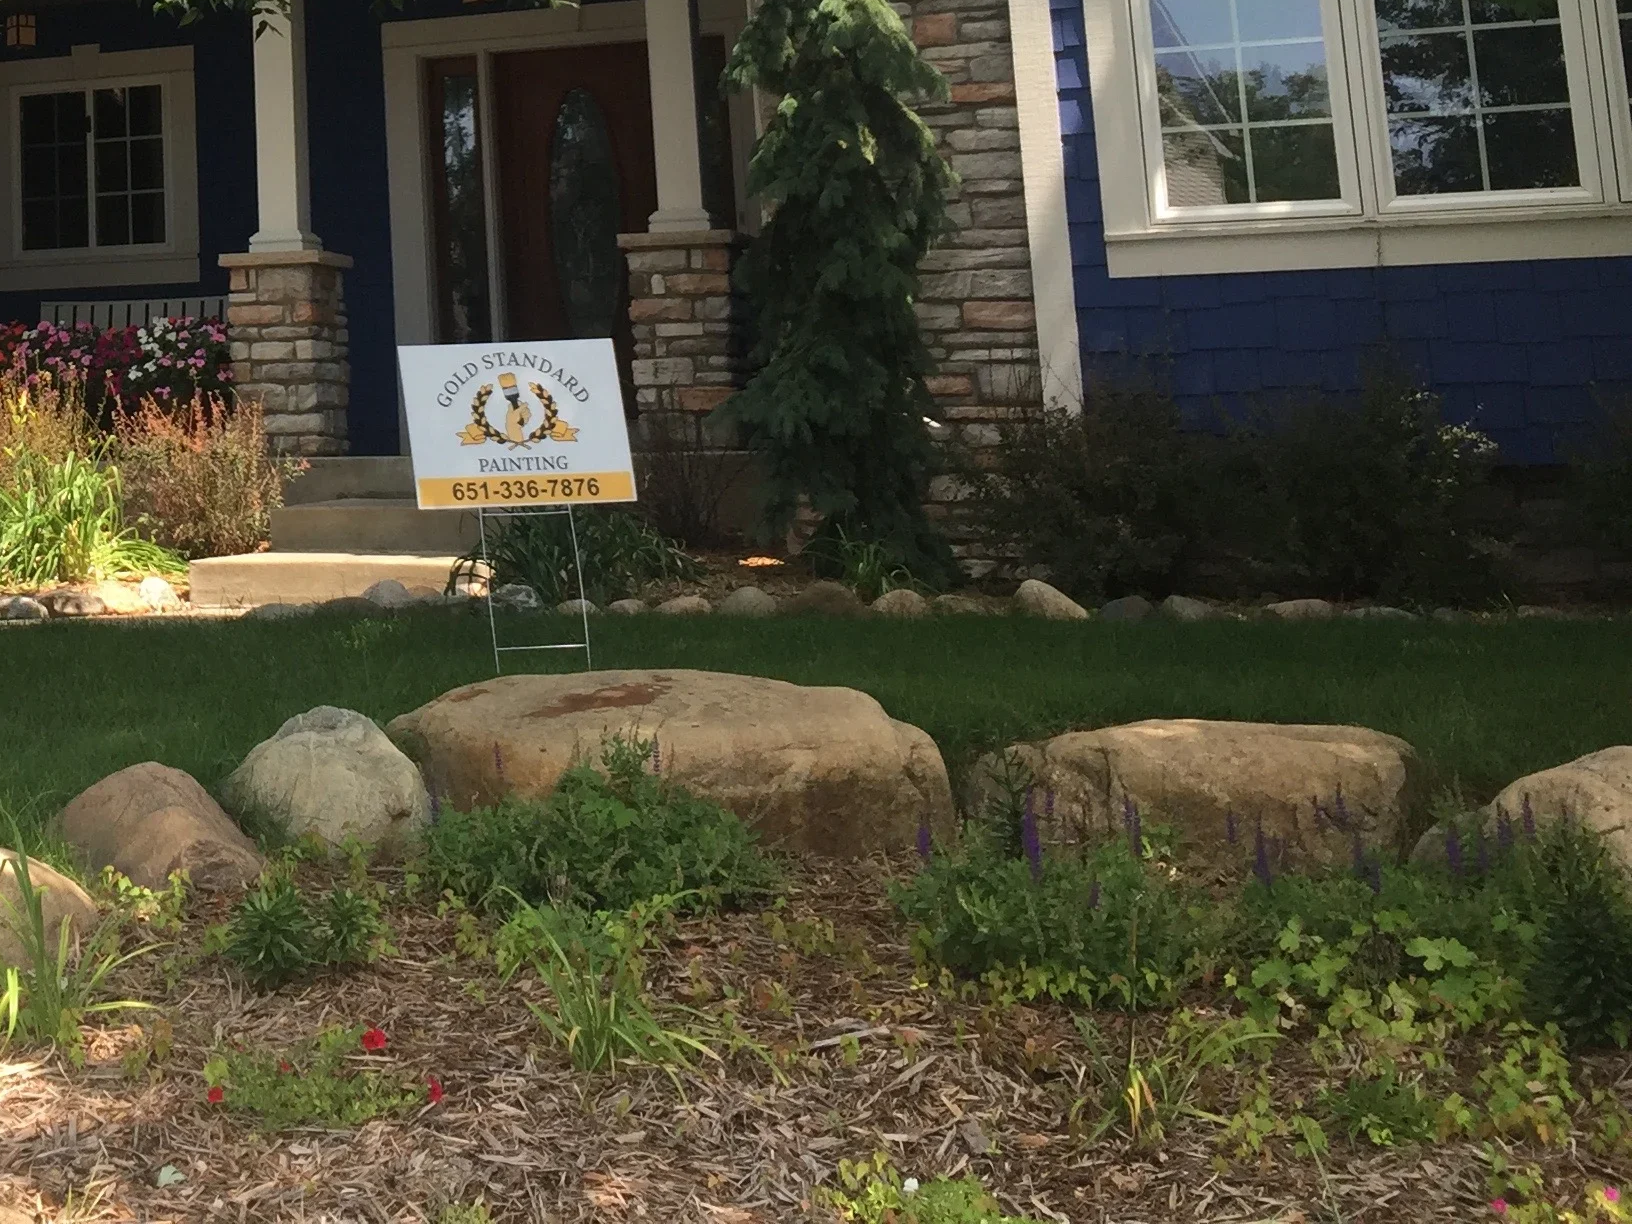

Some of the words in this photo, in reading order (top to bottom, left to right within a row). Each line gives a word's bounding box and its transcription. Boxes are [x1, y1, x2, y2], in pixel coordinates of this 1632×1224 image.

[437, 362, 478, 408] GOLD
[482, 352, 590, 403] STANDARD
[478, 455, 568, 473] PAINTING
[452, 478, 600, 501] 651-336-7876
